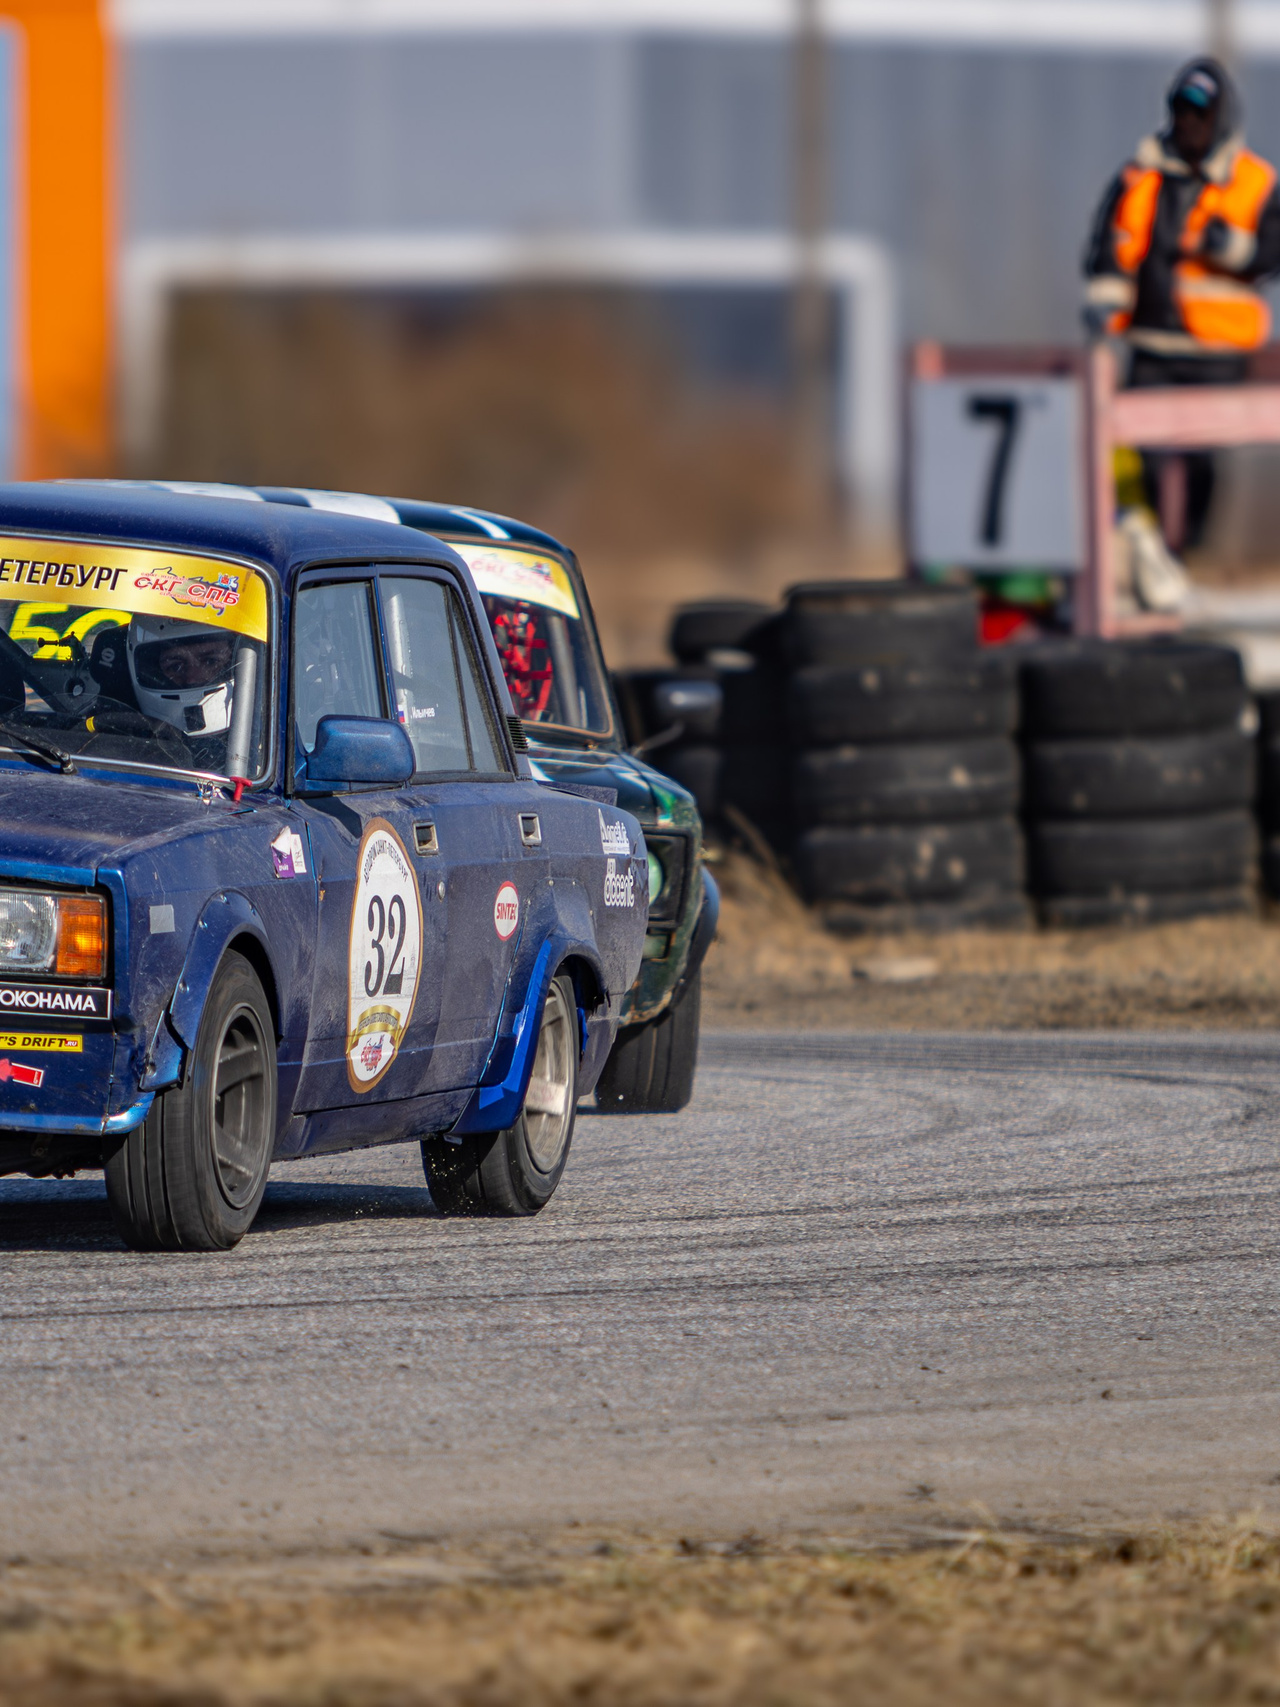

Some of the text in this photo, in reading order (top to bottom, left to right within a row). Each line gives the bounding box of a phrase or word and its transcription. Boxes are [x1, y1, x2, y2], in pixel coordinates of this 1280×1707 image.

[968, 395, 1022, 546] 7
[134, 576, 182, 592] СКГ
[187, 584, 240, 605] СПБ
[364, 894, 407, 998] 32
